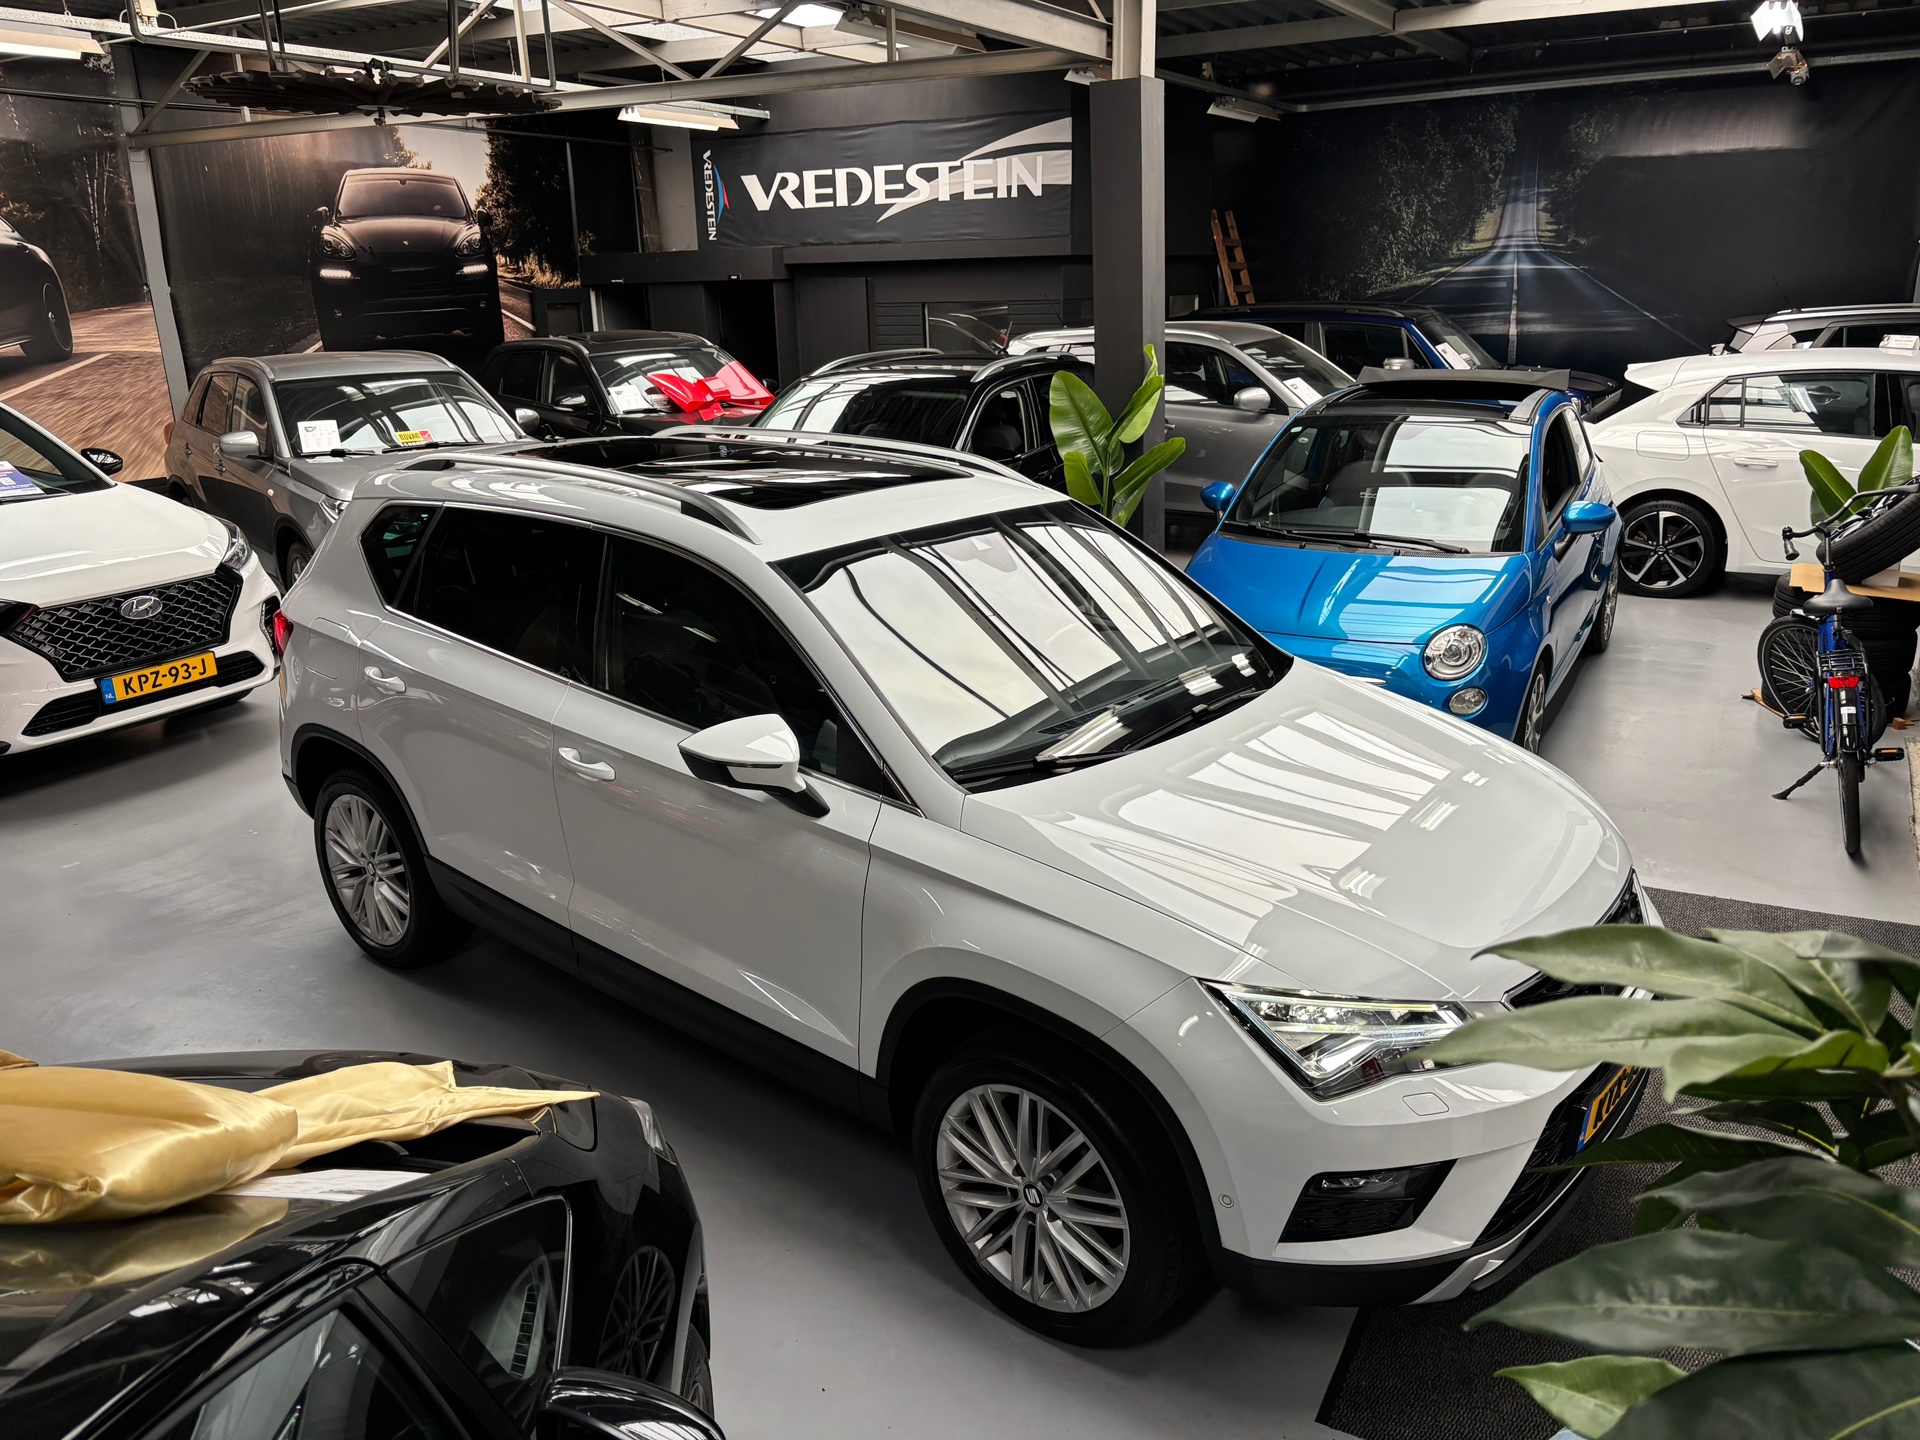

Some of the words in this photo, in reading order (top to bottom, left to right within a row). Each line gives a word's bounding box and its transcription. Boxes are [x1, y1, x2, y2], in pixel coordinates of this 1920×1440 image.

[702, 150, 717, 241] VREDESTEIN
[740, 155, 1043, 212] VREDESTEIN
[122, 658, 207, 696] KPZ-93-J
